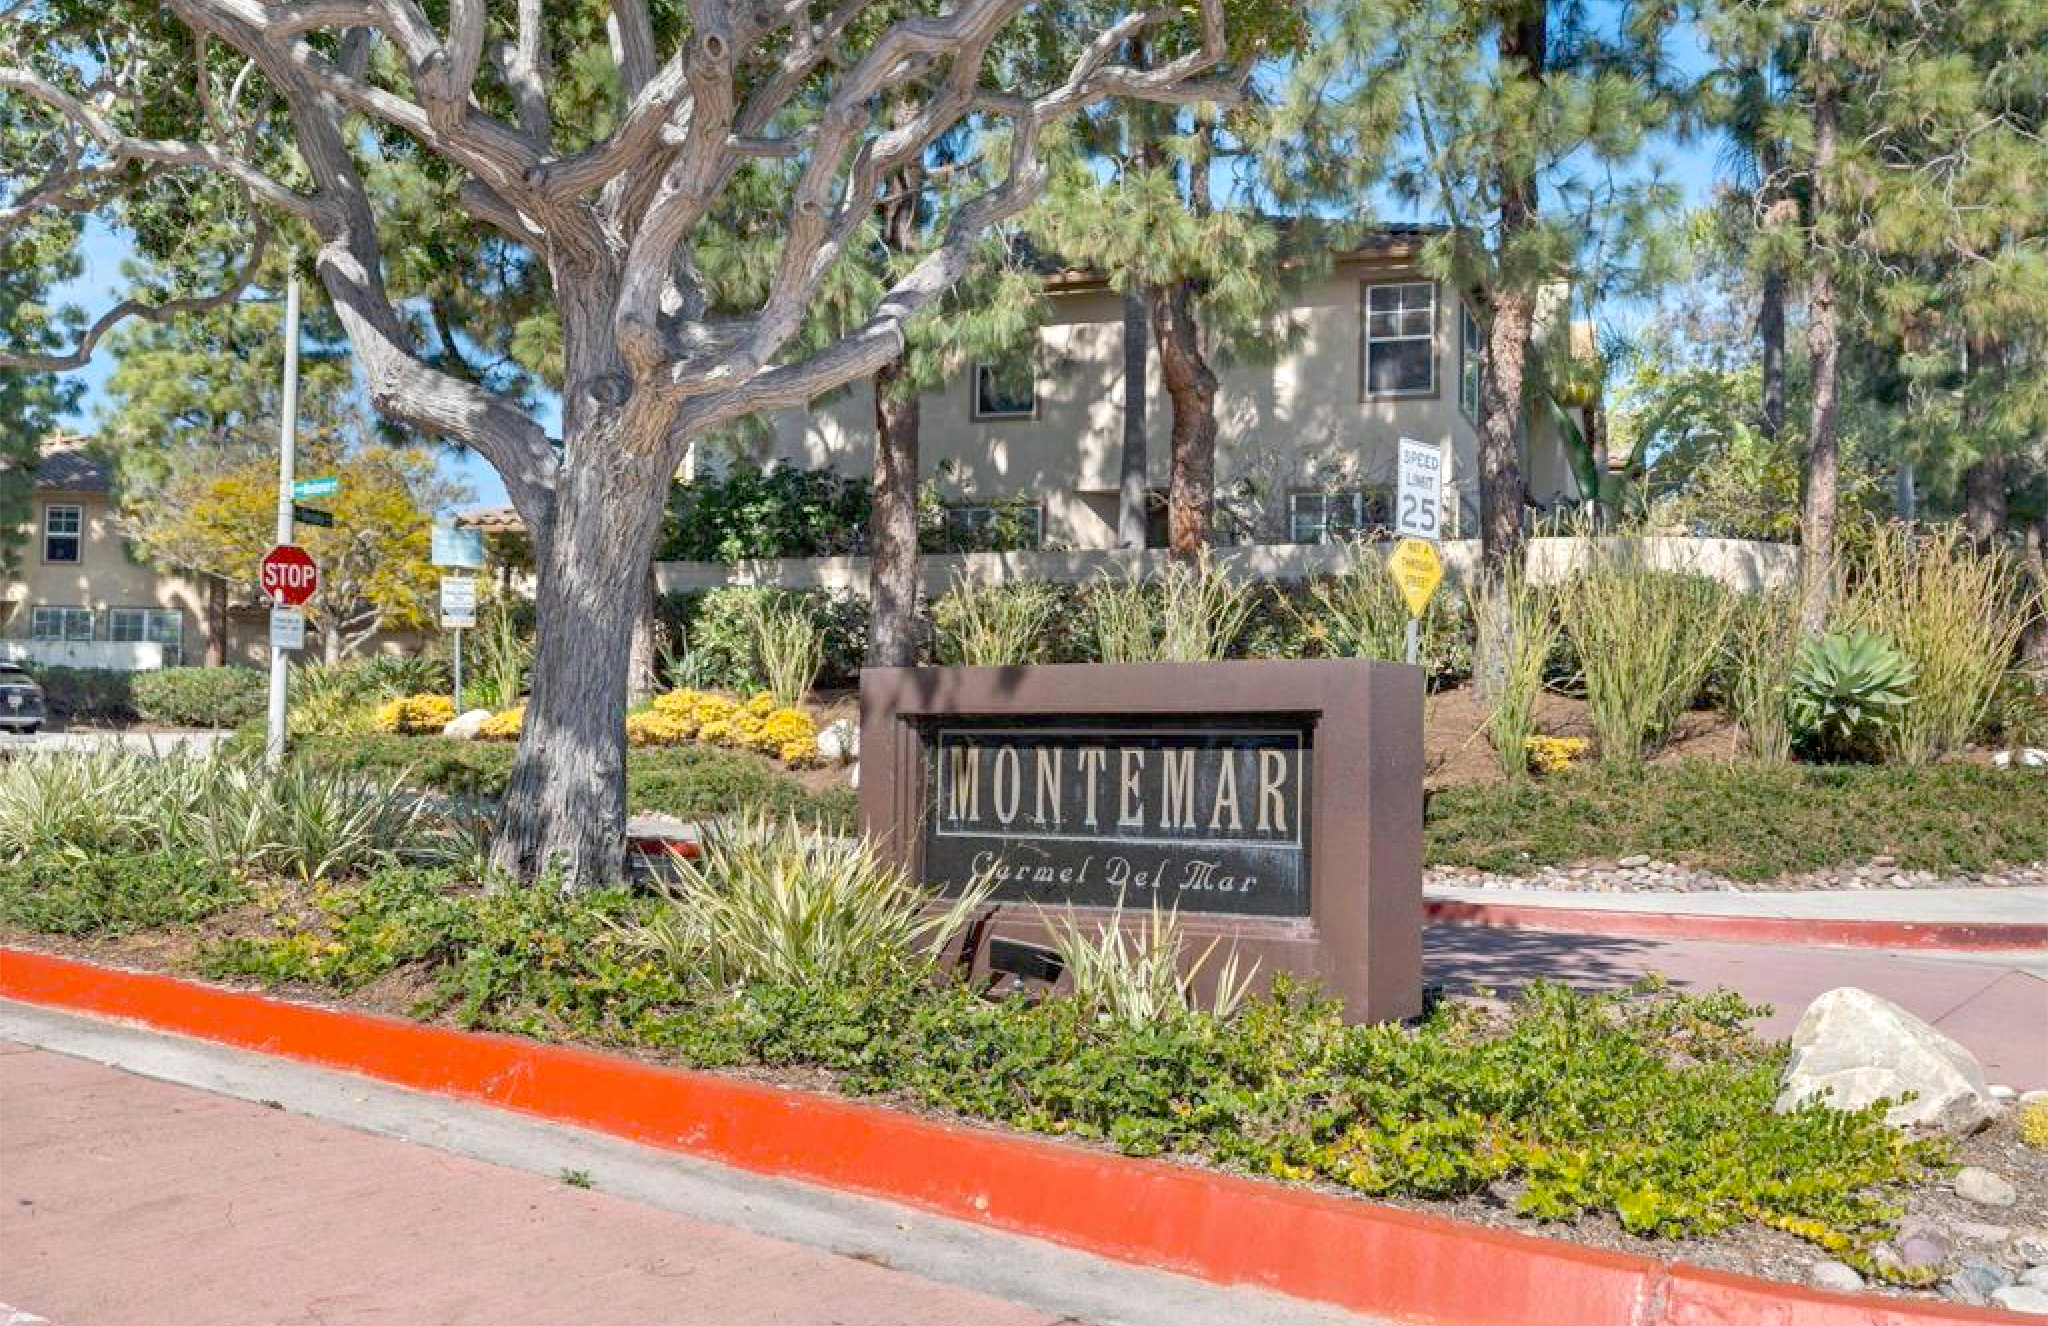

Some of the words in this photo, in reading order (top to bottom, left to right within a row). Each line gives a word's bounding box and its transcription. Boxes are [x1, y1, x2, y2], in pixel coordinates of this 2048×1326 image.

[1403, 448, 1439, 470] SPEED
[1406, 472, 1433, 491] LIMIT
[1402, 495, 1436, 532] 25
[265, 562, 315, 588] STOP
[948, 746, 1288, 832] MONTEMAR
[1105, 856, 1169, 889] Del
[1180, 860, 1258, 893] Mar
